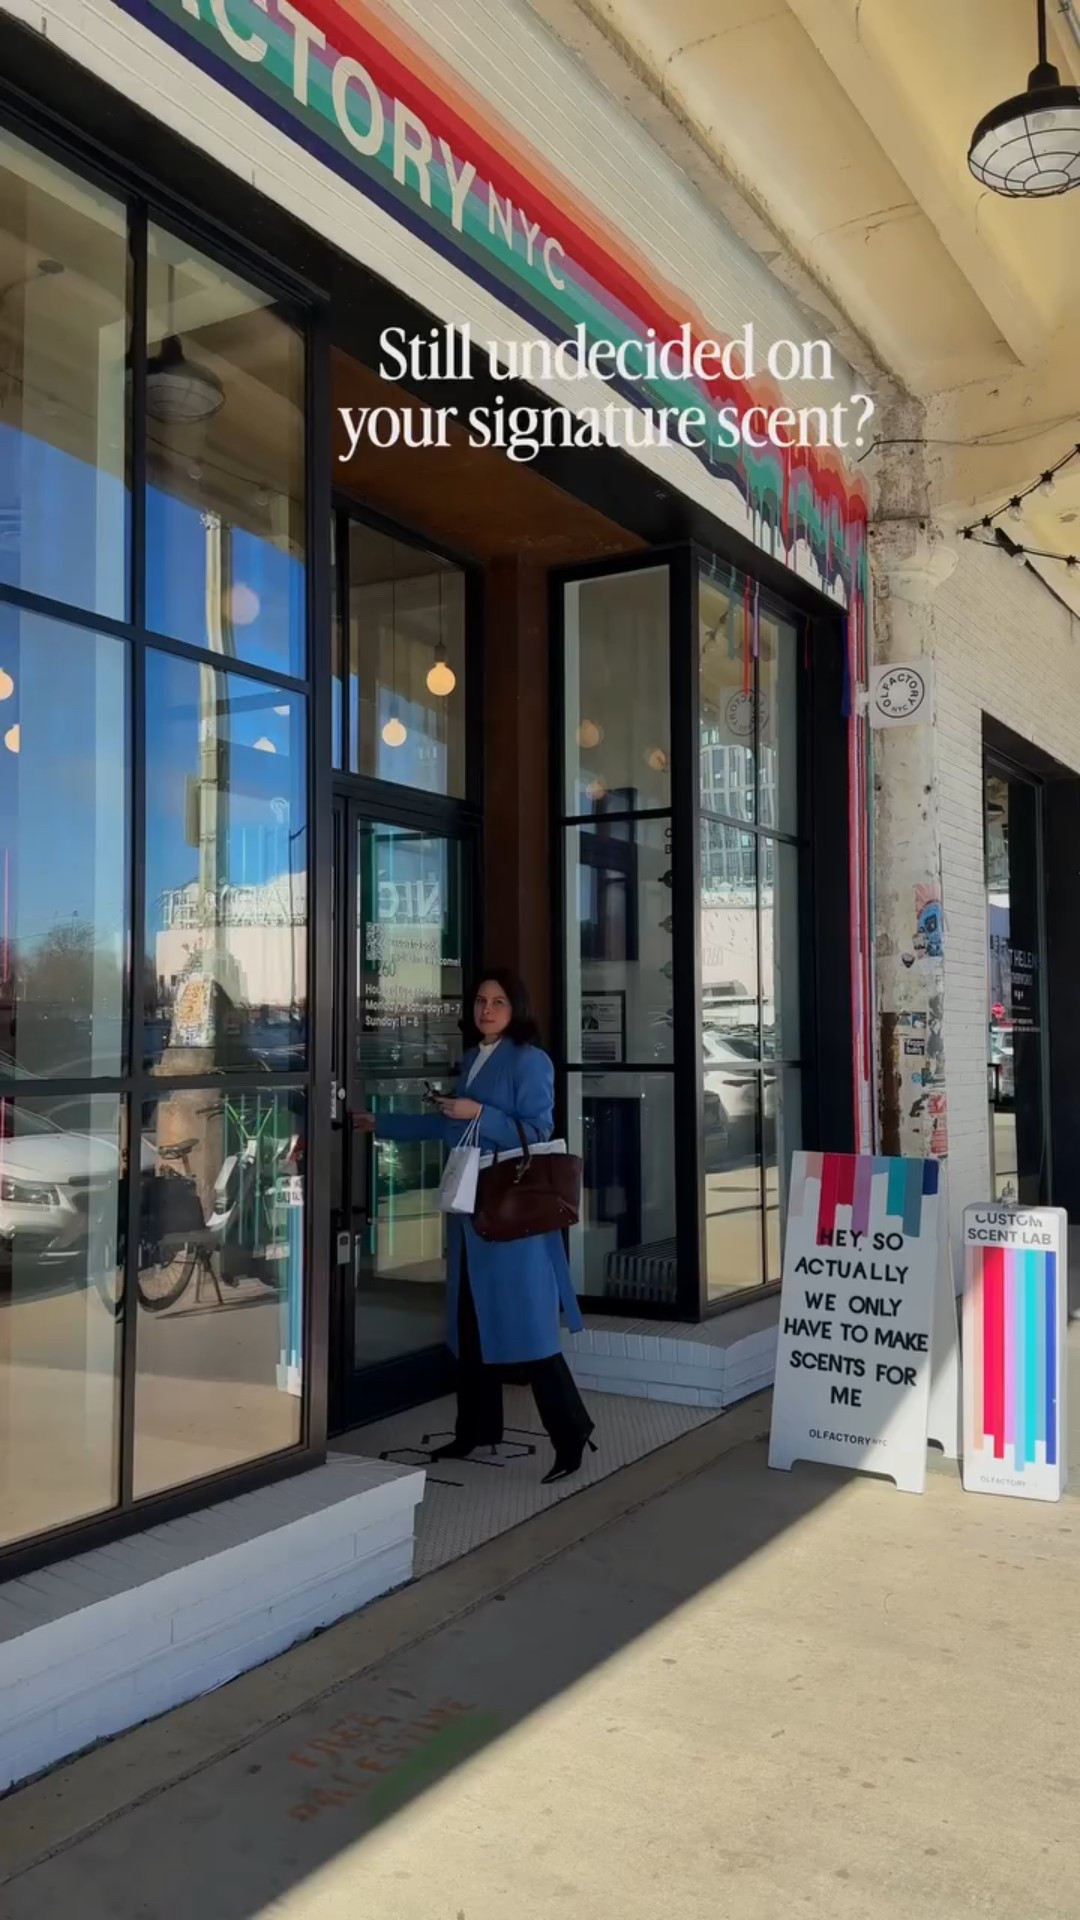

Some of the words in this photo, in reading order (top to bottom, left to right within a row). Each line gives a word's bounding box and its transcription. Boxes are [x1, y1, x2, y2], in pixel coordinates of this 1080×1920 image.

[182, 0, 476, 233] CTORY
[488, 181, 566, 291] NYC
[880, 672, 919, 708] OLFACTORY
[891, 704, 908, 712] NYC
[975, 1212, 1043, 1228] CUSTOM
[872, 1232, 904, 1252] SO
[967, 1228, 1018, 1243] SCENT
[1022, 1231, 1052, 1246] LAB
[794, 1256, 909, 1285] ACTUALLY
[804, 1290, 837, 1312] WE
[848, 1295, 903, 1317] ONLY
[783, 1316, 832, 1341] HAVE
[840, 1322, 868, 1344] TO
[874, 1327, 929, 1353] MAKE
[789, 1349, 866, 1378] SCENTS
[875, 1364, 918, 1387] FOR
[830, 1385, 862, 1408] ME
[808, 1428, 871, 1446] OLFACTORY
[980, 1475, 1026, 1487] OLFACTORY
